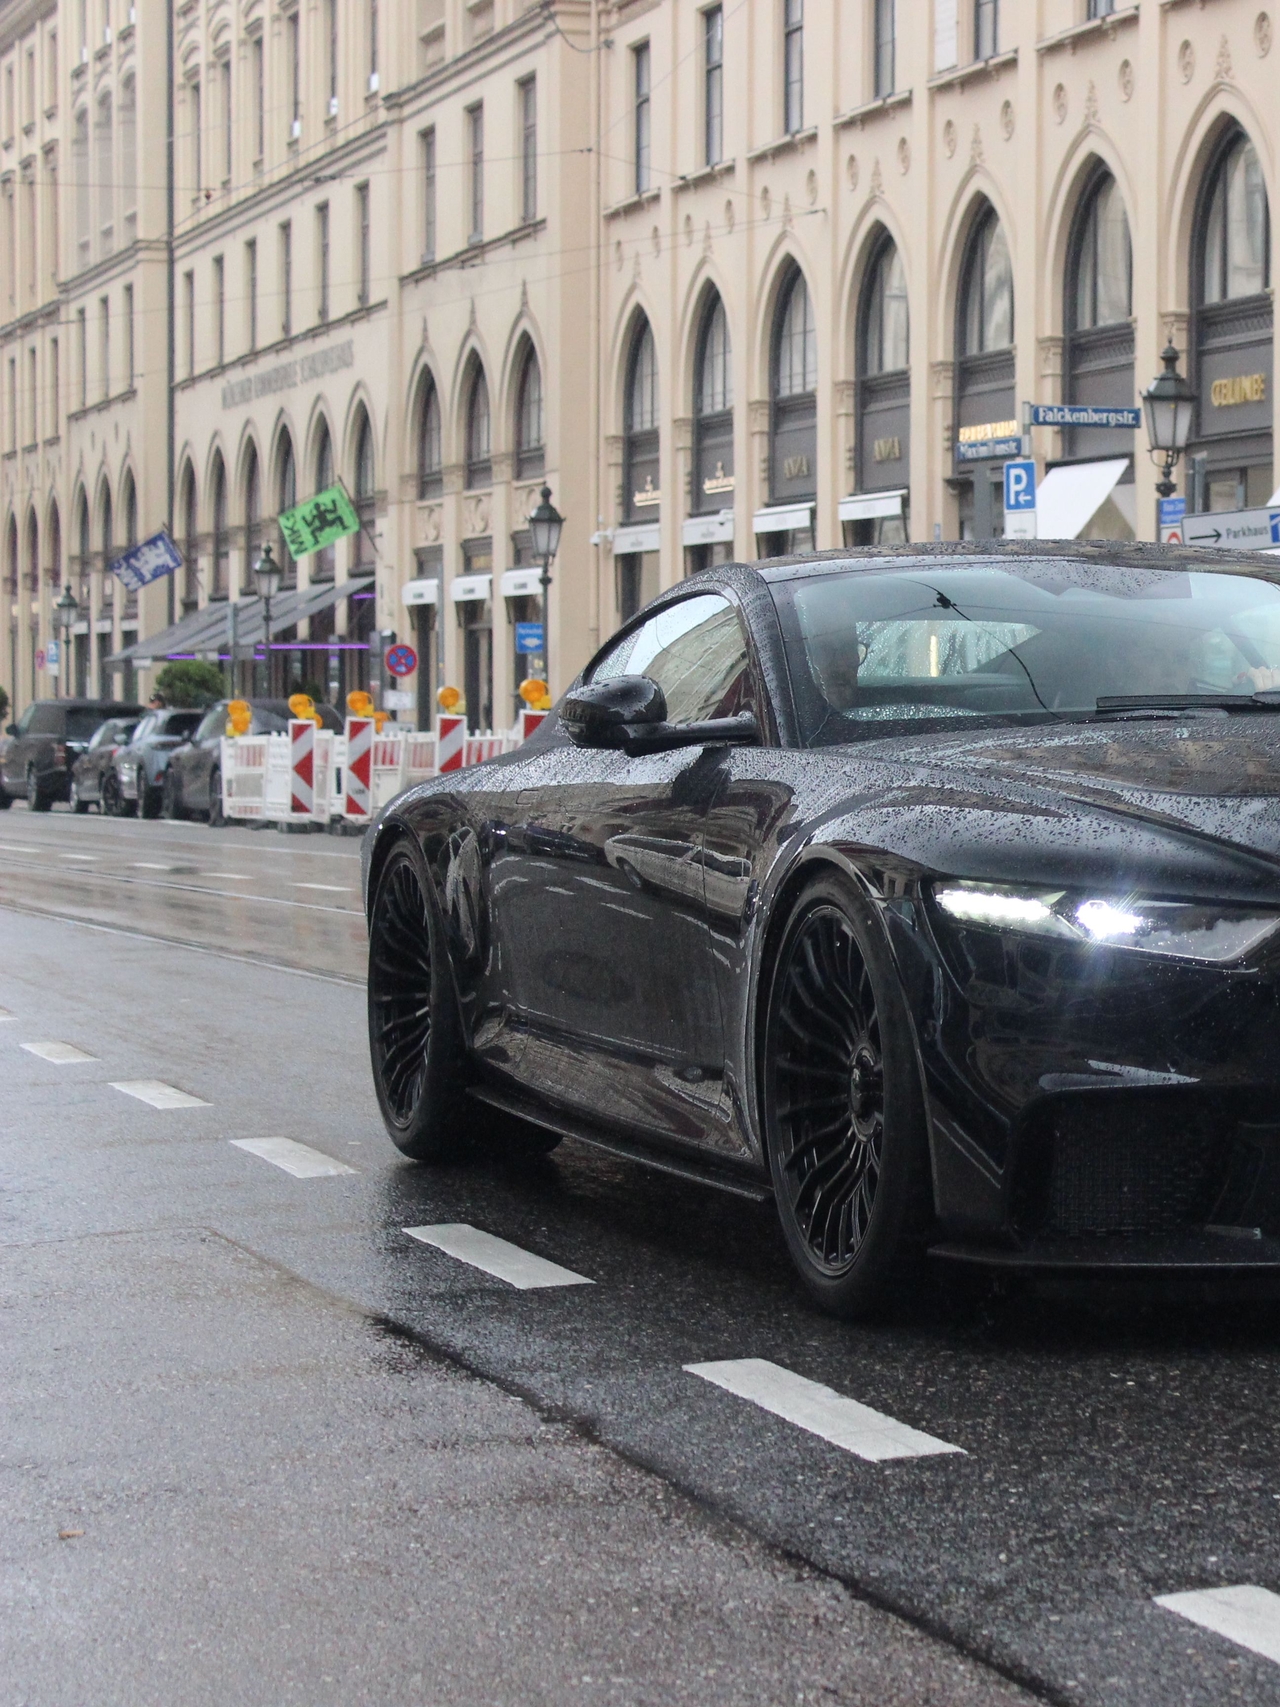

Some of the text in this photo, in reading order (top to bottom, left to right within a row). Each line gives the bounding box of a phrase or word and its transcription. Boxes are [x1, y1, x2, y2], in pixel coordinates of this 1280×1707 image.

[1038, 407, 1136, 427] Falckenbergstr.
[1009, 467, 1028, 506] P
[1225, 525, 1269, 540] Parkhaus
